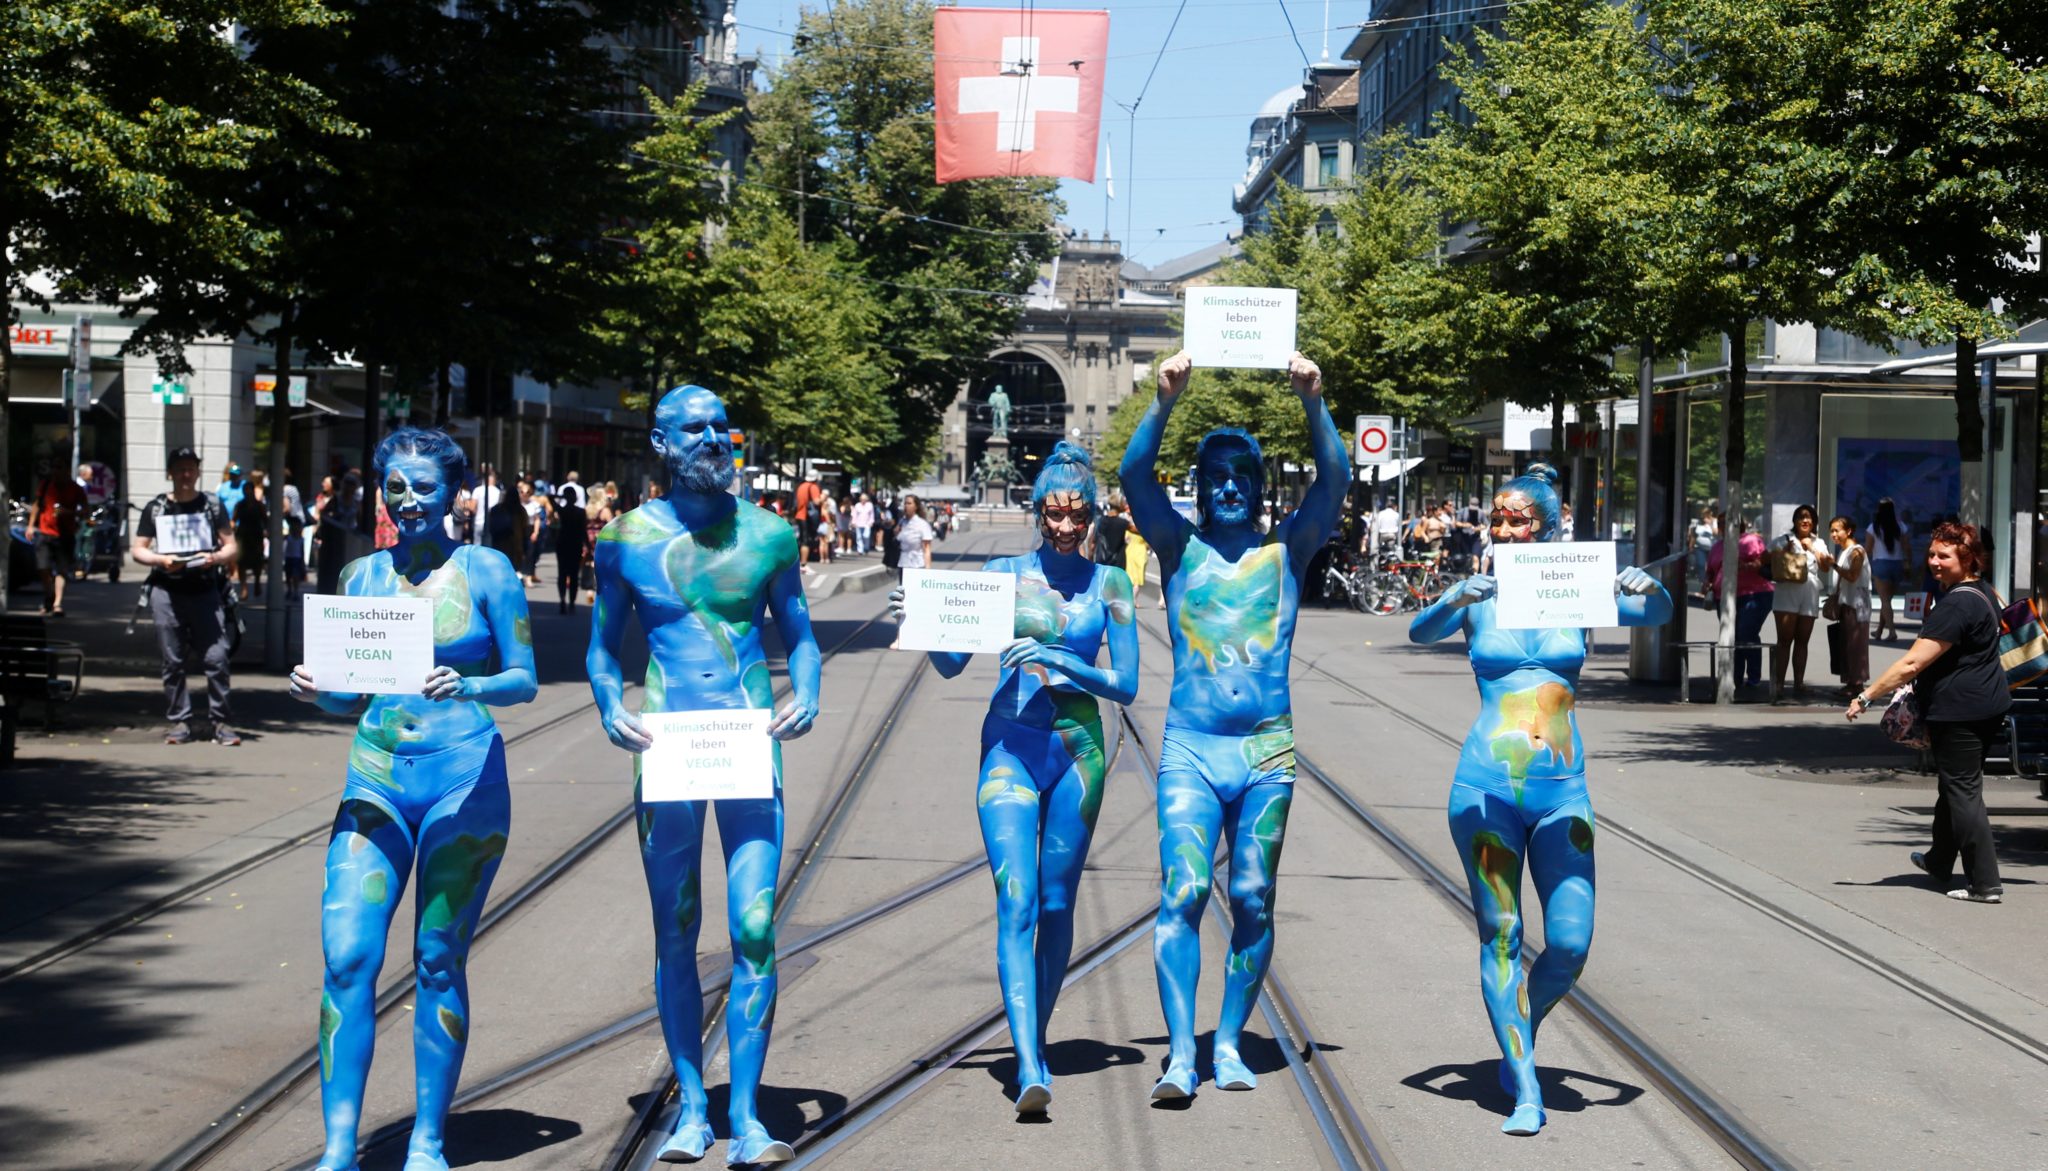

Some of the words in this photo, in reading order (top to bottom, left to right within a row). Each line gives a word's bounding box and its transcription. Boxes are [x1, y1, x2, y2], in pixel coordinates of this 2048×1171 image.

[1203, 296, 1282, 308] Klimaschützer
[1226, 312, 1257, 323] leben
[1221, 329, 1262, 340] VEGAN
[1514, 552, 1600, 564] Klimaschützer
[1541, 570, 1574, 581] leben
[921, 579, 1001, 592] Klimaschützer
[1536, 588, 1580, 599] VEGAN
[944, 596, 976, 607] leben
[323, 607, 415, 621] Klimaschützer
[938, 614, 980, 625] VEGAN
[350, 627, 386, 639] leben
[345, 648, 392, 660] VEGAN
[663, 721, 754, 734] Klimaschützer
[691, 738, 726, 750] leben
[686, 757, 732, 769] VEGAN
